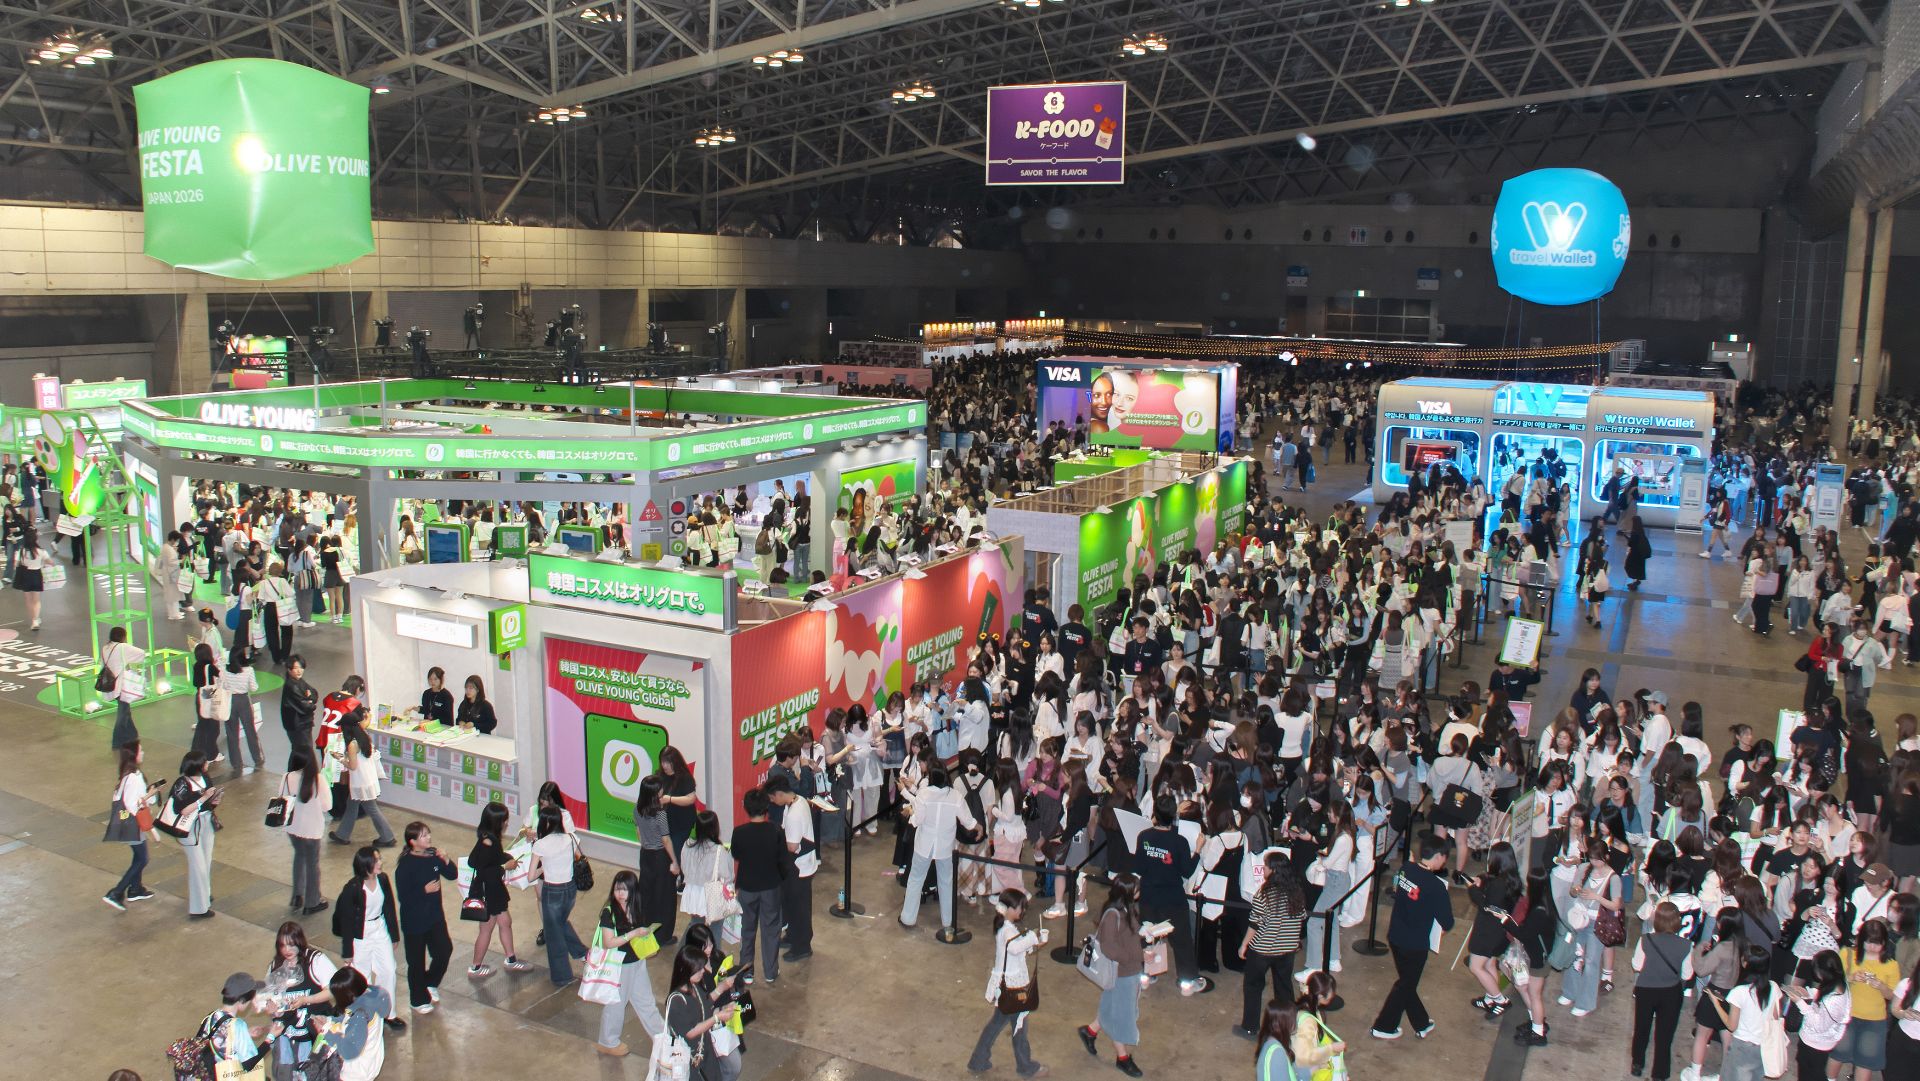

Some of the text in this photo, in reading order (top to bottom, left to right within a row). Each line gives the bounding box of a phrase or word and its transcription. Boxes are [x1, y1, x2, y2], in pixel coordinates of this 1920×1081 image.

[1051, 97, 1057, 106] 6
[163, 125, 222, 144] YOUNG
[1015, 119, 1095, 139] K-FOOD
[143, 149, 204, 178] FESTA
[326, 155, 368, 177] YOUNG
[147, 188, 204, 205] JAPAN 2026
[1512, 252, 1593, 264] travel Wallet
[1044, 366, 1080, 382] VISA
[42, 382, 57, 408] 韓国
[73, 384, 140, 400] コスメランキング
[201, 401, 316, 431] OLIVE YOUNG
[1417, 400, 1452, 414] VISA
[1618, 415, 1652, 426] travel
[1656, 416, 1695, 428] Wallet
[456, 448, 638, 461] 韓国に行かなくても、韓国コスメはオリグロで。
[1224, 515, 1240, 534] FESTA
[1082, 558, 1119, 584] OLIVE YOUNG
[548, 571, 705, 612] 韓国コスメはオリグロで。
[1087, 576, 1114, 601] FESTA
[907, 626, 964, 662] OLIVE YOUNG
[915, 646, 956, 682] FESTA
[560, 660, 690, 694] 韓国コスメ、安心して買うなら、
[576, 680, 674, 708] OLIVE YOUNG Global
[321, 708, 342, 729] 22
[740, 688, 820, 737] OLIVE YOUNG
[1146, 850, 1164, 859] FESTA
